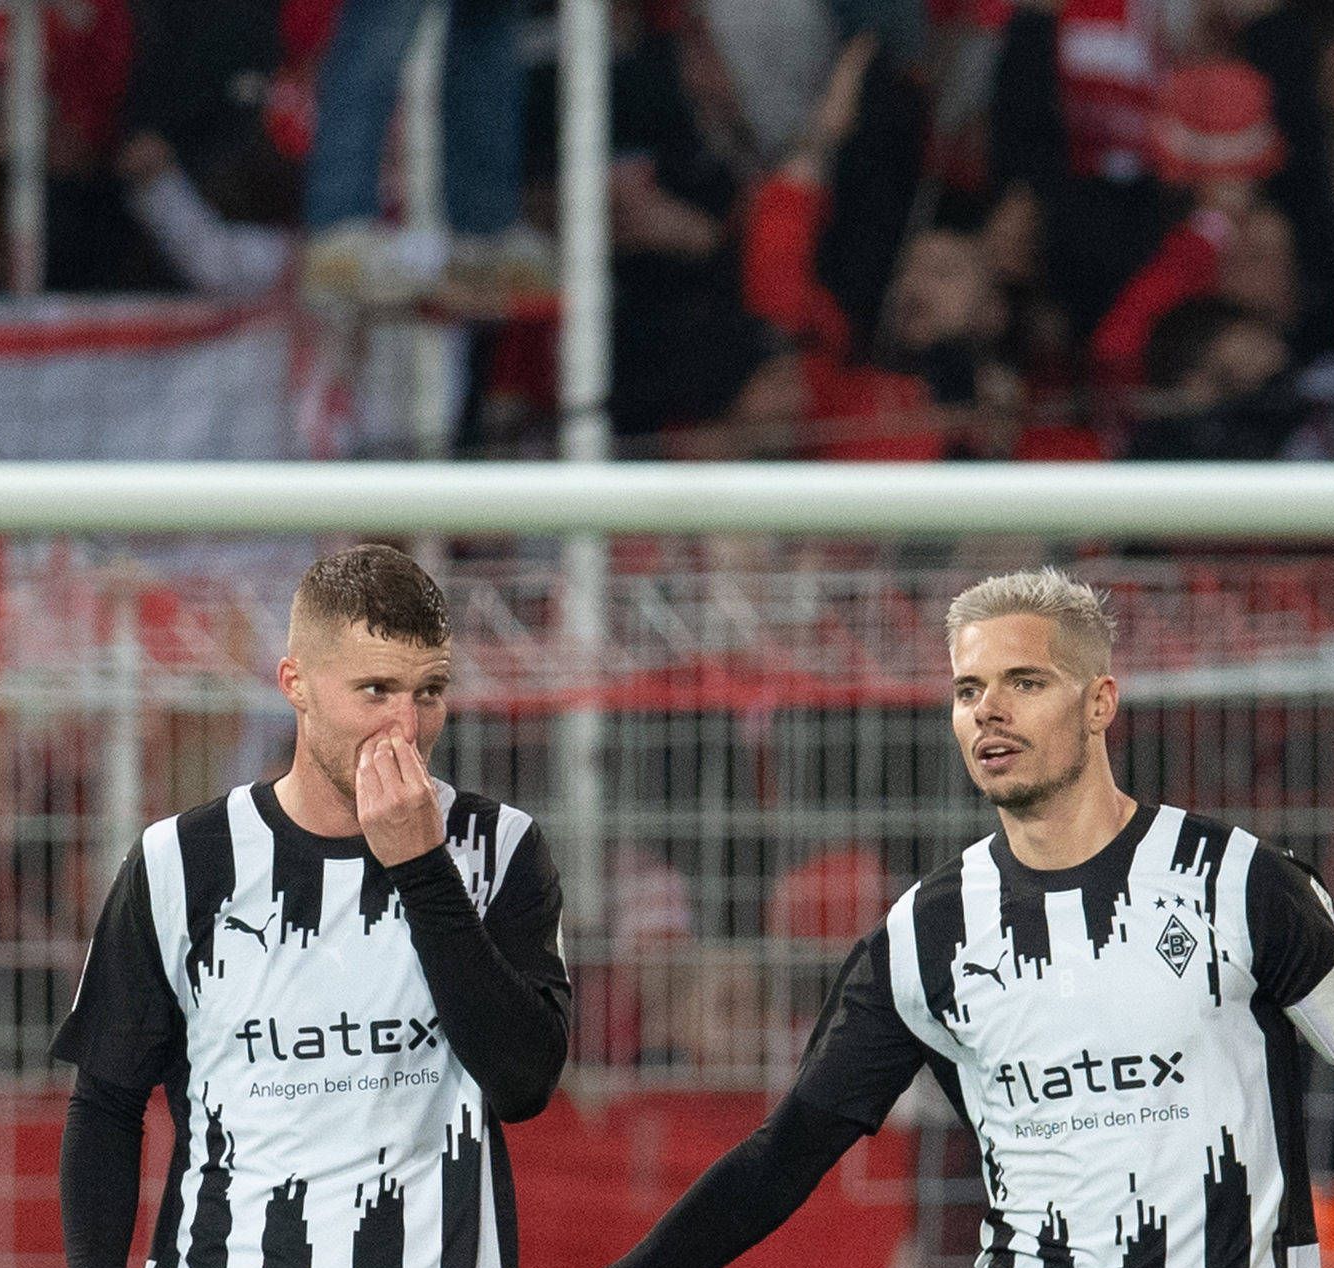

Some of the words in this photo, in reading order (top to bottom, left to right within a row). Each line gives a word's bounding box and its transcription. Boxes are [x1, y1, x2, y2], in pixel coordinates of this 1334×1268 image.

[235, 1011, 441, 1063] flatex
[249, 1081, 319, 1100] Anlegen
[324, 1075, 352, 1093] bei
[357, 1074, 390, 1090] den
[393, 1067, 440, 1087] Profis
[995, 1049, 1185, 1107] flatex
[1015, 1119, 1068, 1140] Anlegen
[1070, 1114, 1099, 1131] bei
[1104, 1110, 1136, 1126] den
[1140, 1103, 1190, 1124] Profis
